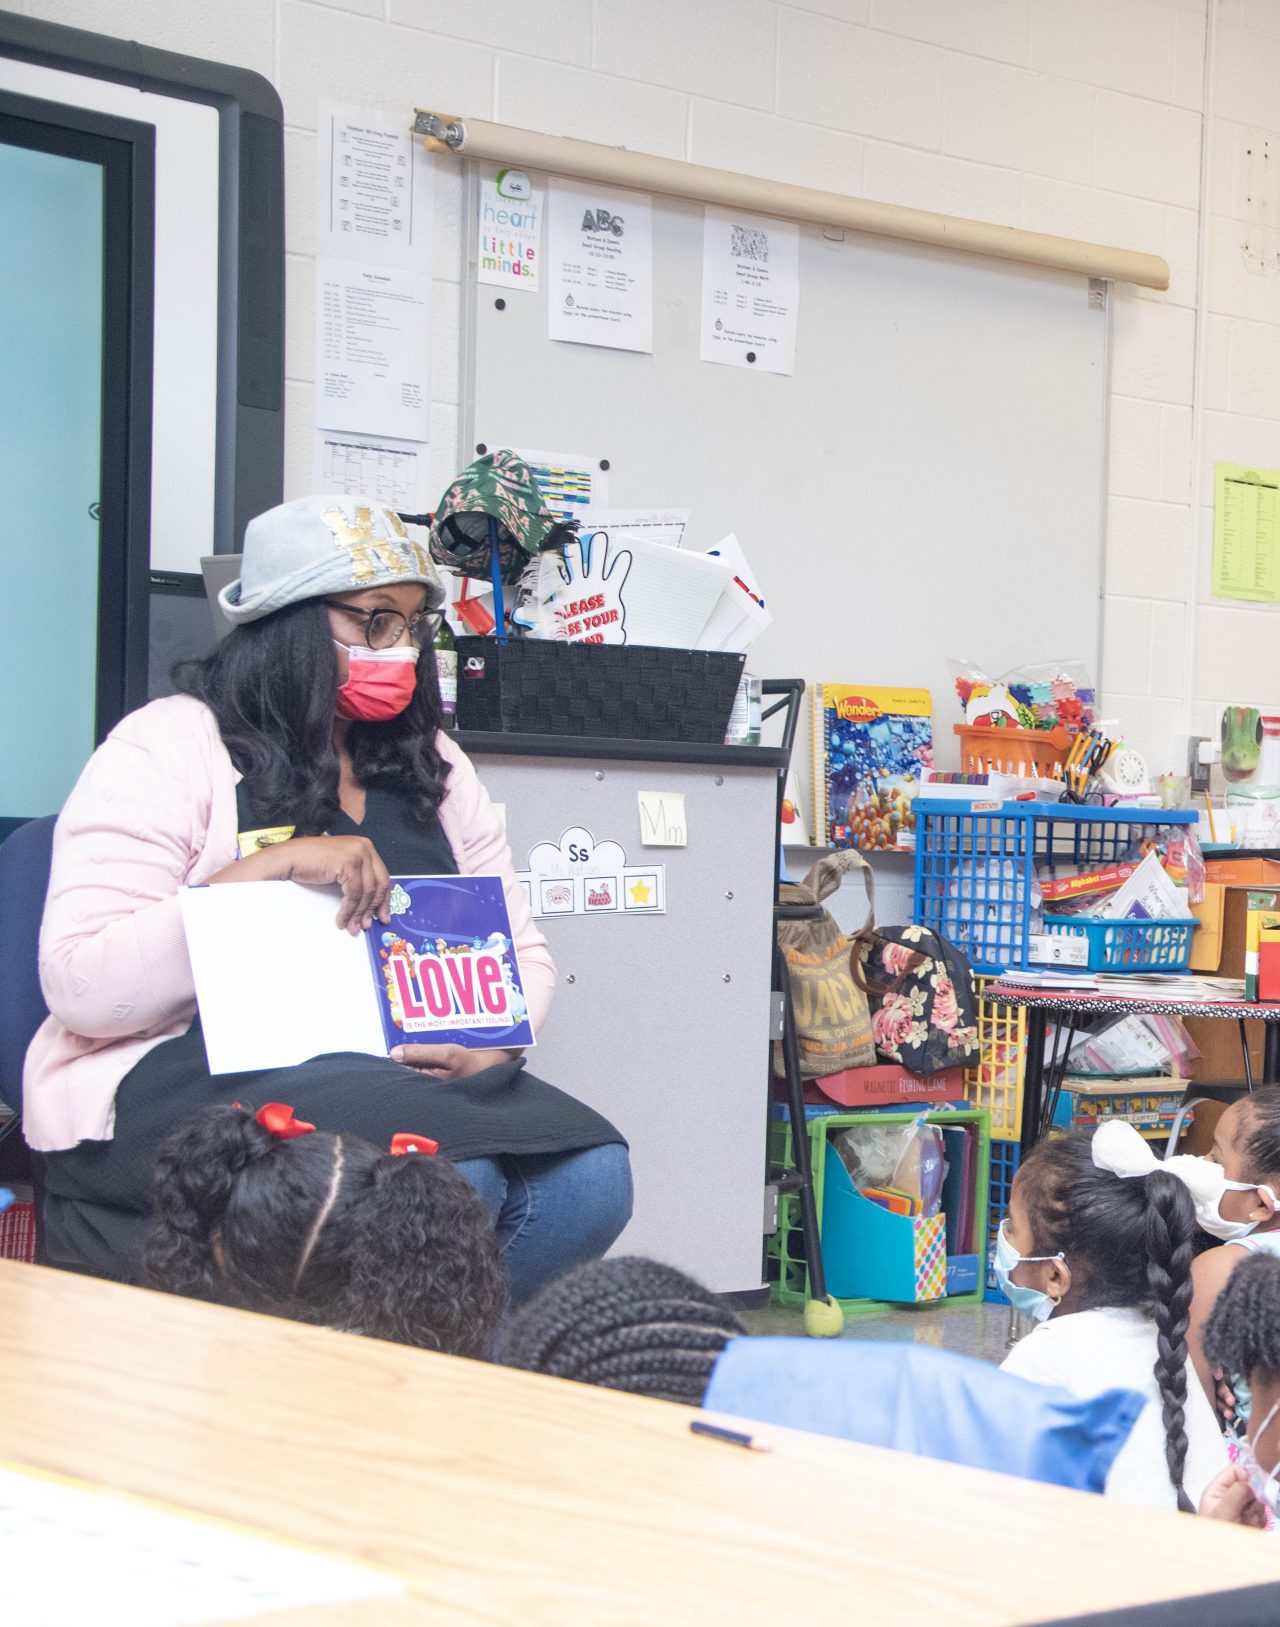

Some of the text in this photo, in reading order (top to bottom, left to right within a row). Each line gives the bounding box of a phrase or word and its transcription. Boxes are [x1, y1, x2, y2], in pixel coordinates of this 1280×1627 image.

[484, 201, 536, 231] heart
[581, 208, 625, 237] ABC
[482, 235, 535, 260] little
[482, 256, 535, 278] minds.
[554, 594, 605, 620] LEASE
[583, 608, 619, 631] YOUR
[578, 632, 604, 645] AND
[833, 695, 884, 720] Wonders
[640, 799, 683, 844] Mm
[569, 844, 589, 862] Ss
[415, 1021, 426, 1029] THE
[428, 1020, 446, 1028] MOST
[449, 1018, 484, 1027] IMPORTANT
[863, 1077, 947, 1095] MAGNETIC FISHING GAME
